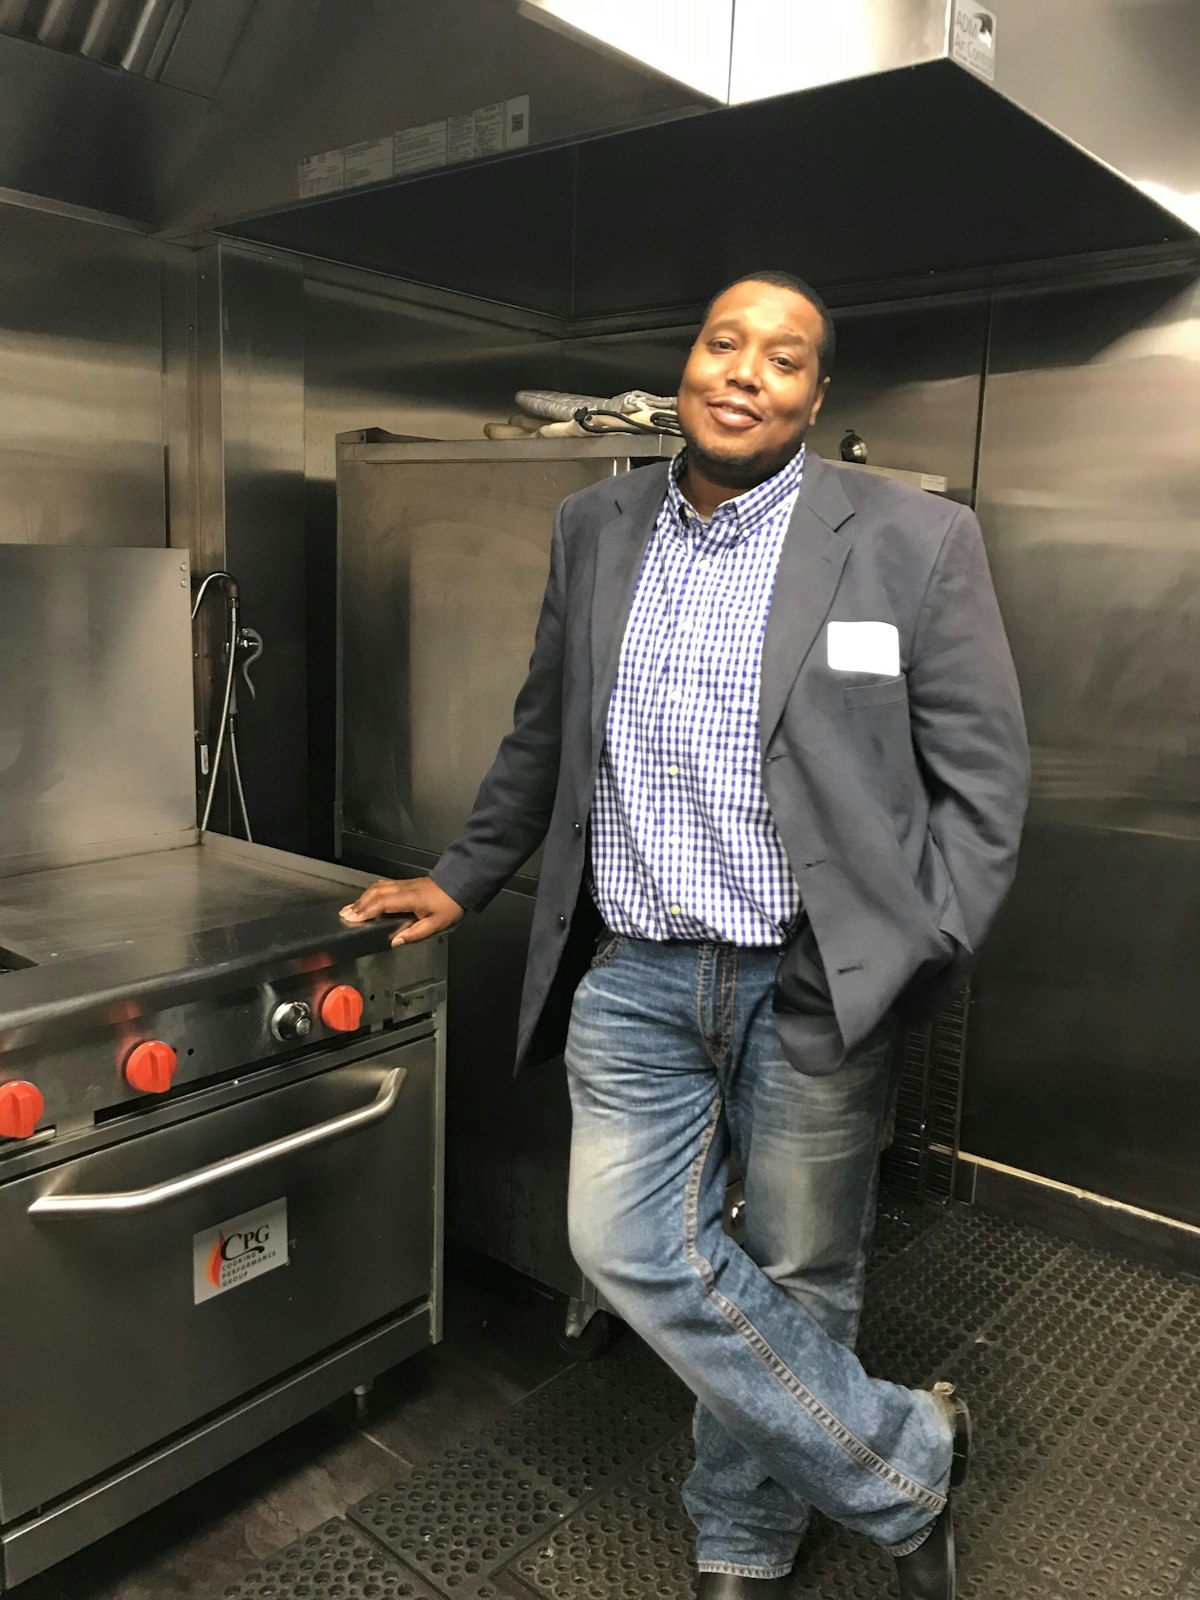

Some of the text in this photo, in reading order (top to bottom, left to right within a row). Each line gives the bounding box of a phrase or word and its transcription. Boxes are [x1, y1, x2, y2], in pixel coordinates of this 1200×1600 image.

[221, 1225, 270, 1261] CPG
[222, 1252, 257, 1271] COOKING
[222, 1250, 276, 1279] PERFORMANCE
[222, 1271, 248, 1287] GROUP
